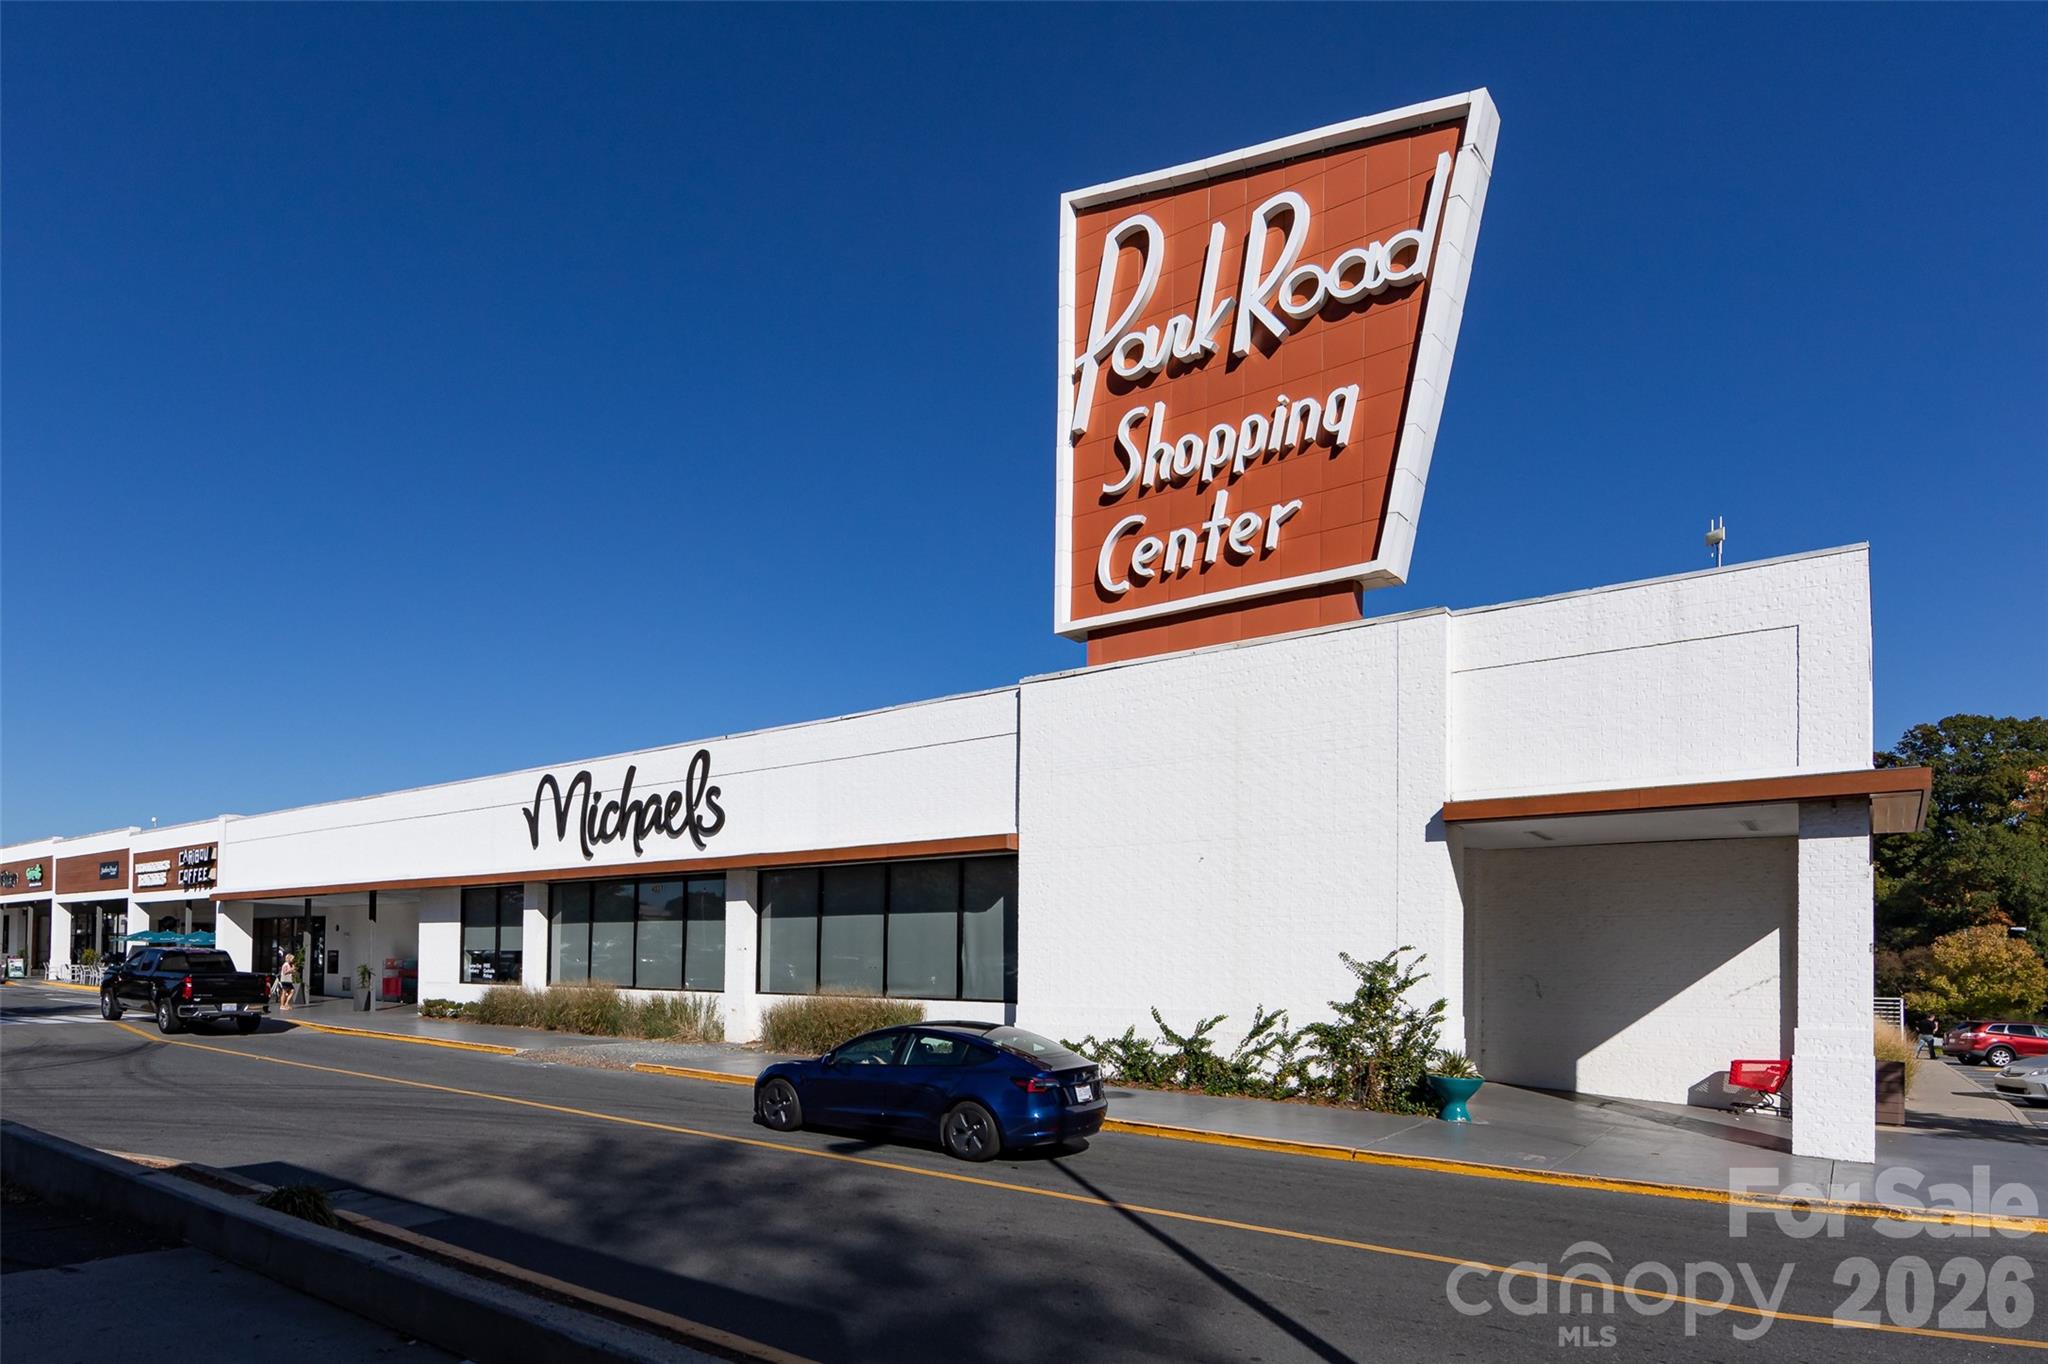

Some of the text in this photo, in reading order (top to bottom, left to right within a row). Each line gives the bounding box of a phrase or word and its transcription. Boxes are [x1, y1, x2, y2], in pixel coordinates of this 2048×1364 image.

[1071, 151, 1452, 435] Park Road
[1102, 384, 1360, 496] Shopping
[1099, 489, 1303, 594] Center
[522, 749, 726, 861] Michaels
[178, 867, 209, 885] COFFEE
